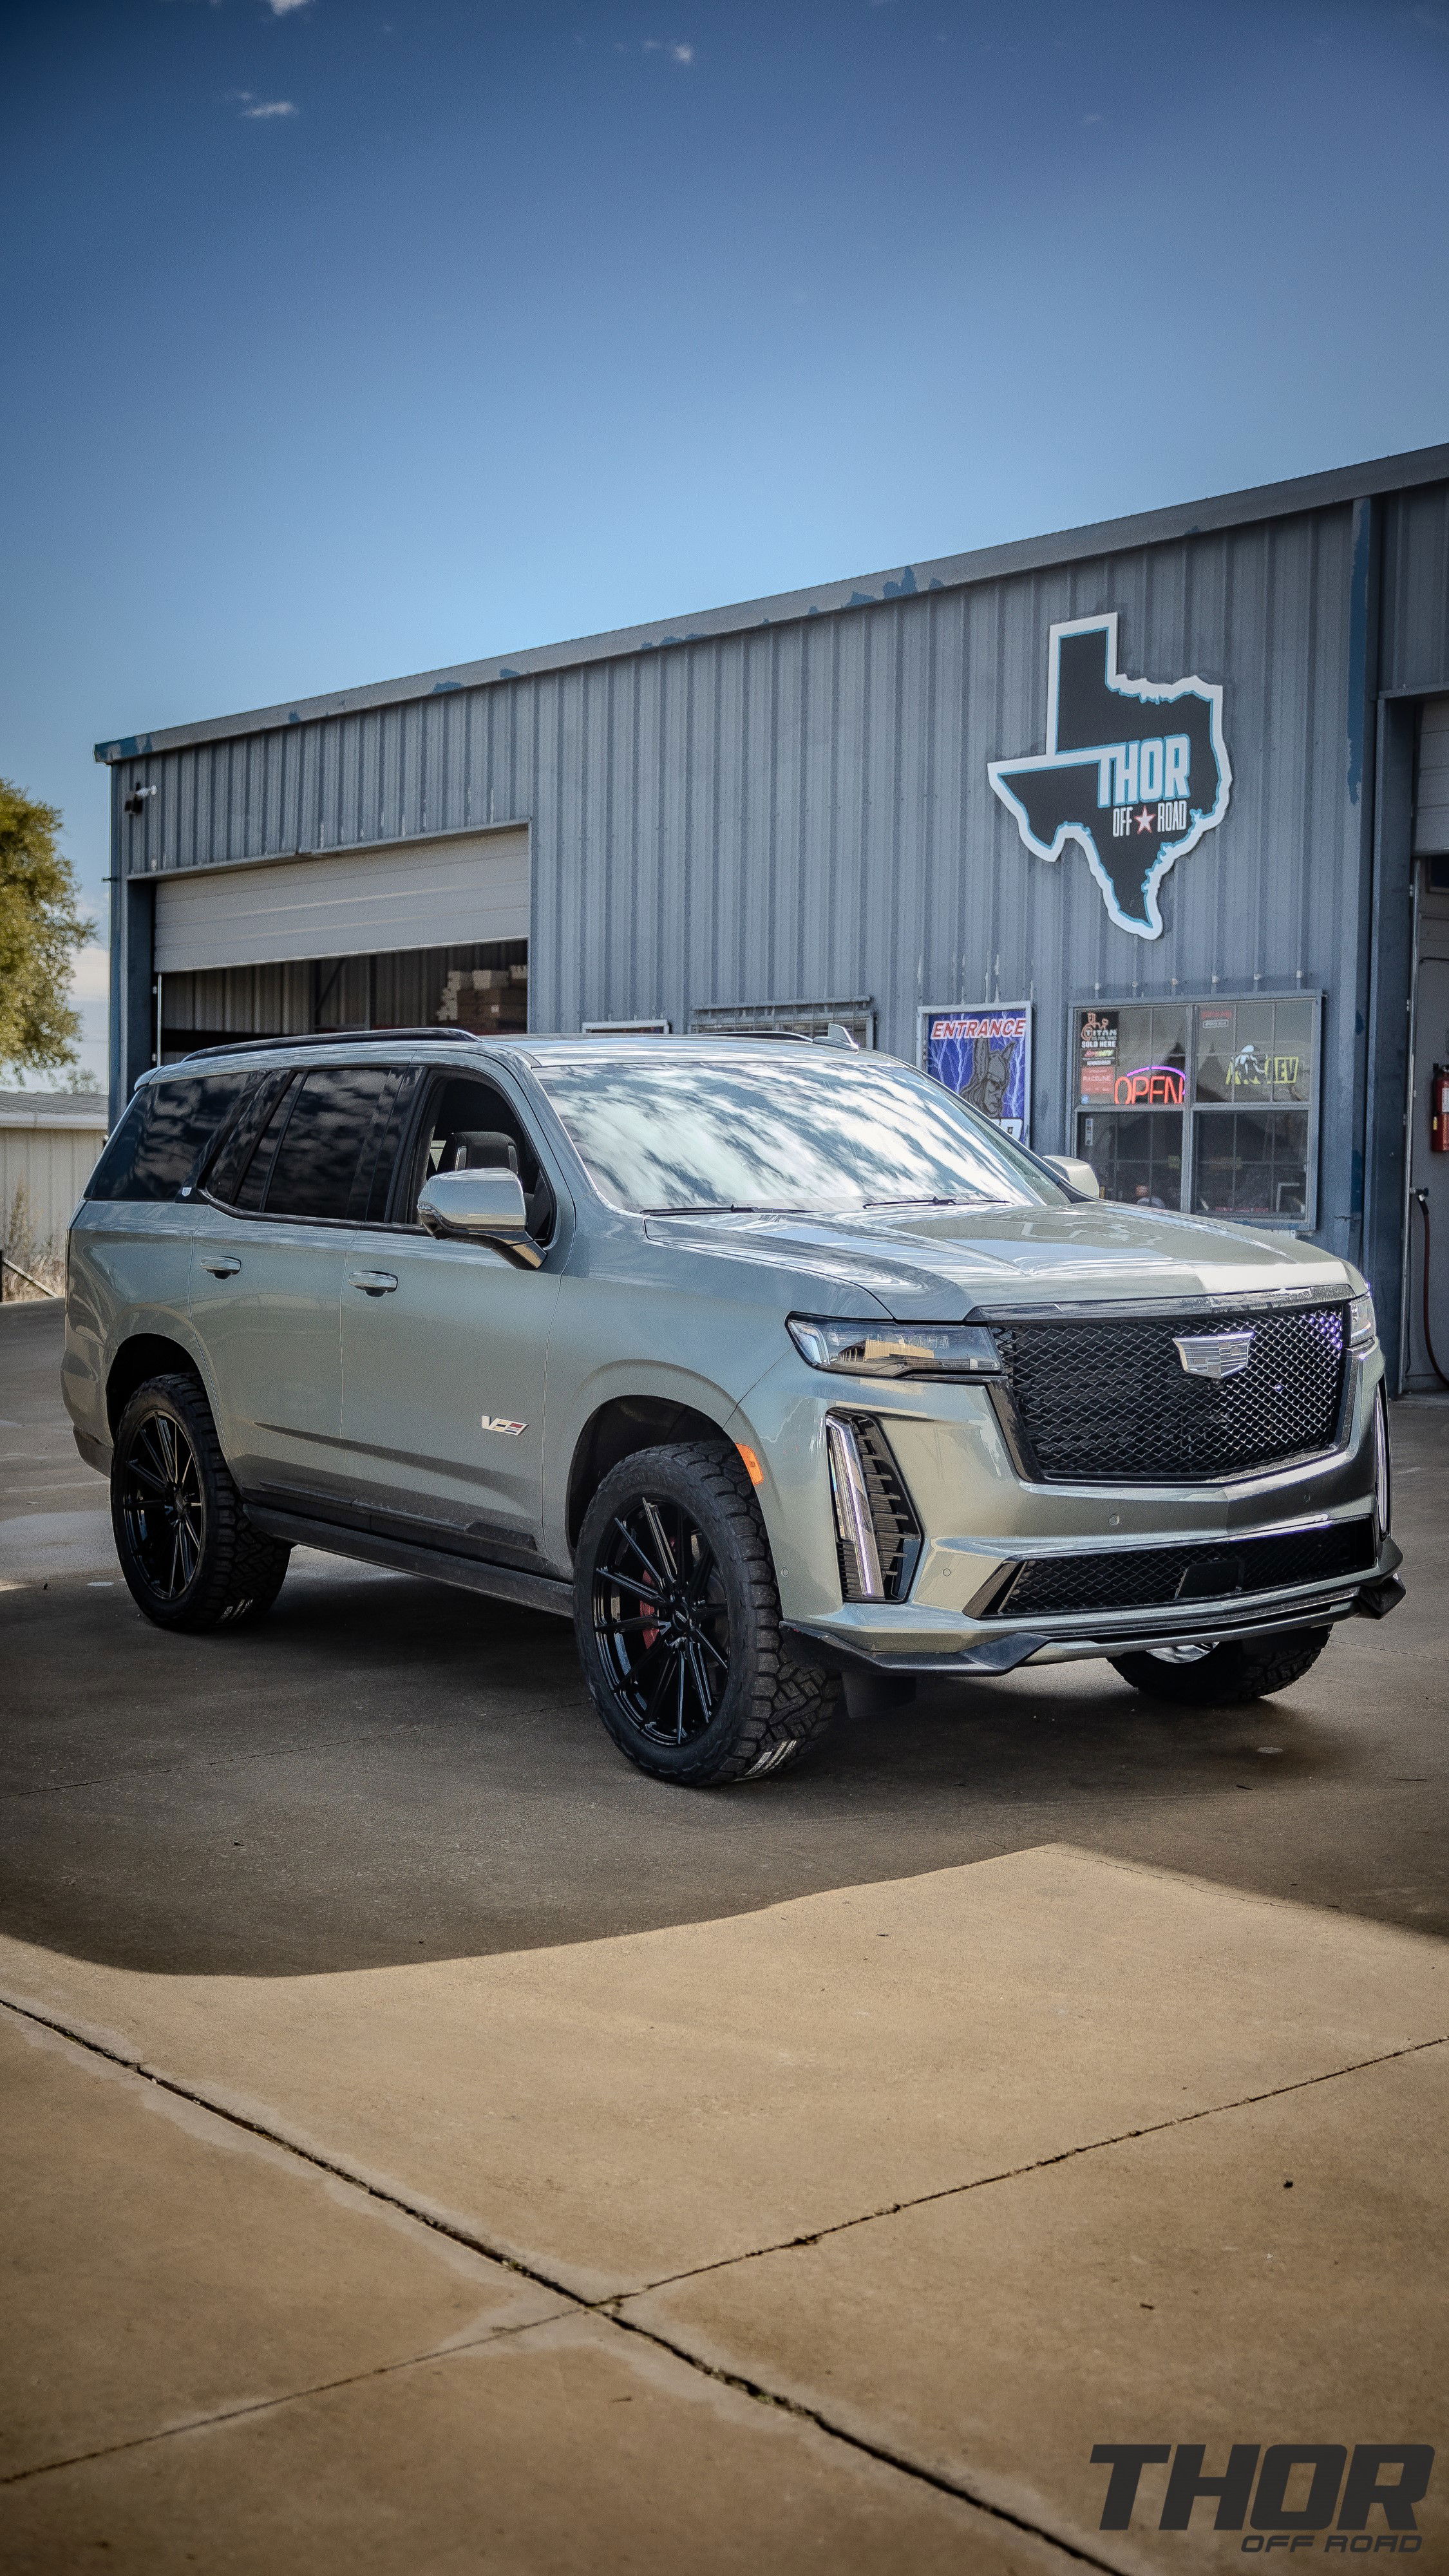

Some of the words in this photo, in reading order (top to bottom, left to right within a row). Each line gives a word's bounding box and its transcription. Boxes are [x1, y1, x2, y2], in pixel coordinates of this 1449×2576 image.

[1096, 734, 1191, 808] THOR
[1112, 806, 1133, 837] OFF
[1157, 800, 1188, 833] ROAD
[931, 1018, 1027, 1039] ENTRANCE
[1113, 1076, 1184, 1104] OPEN
